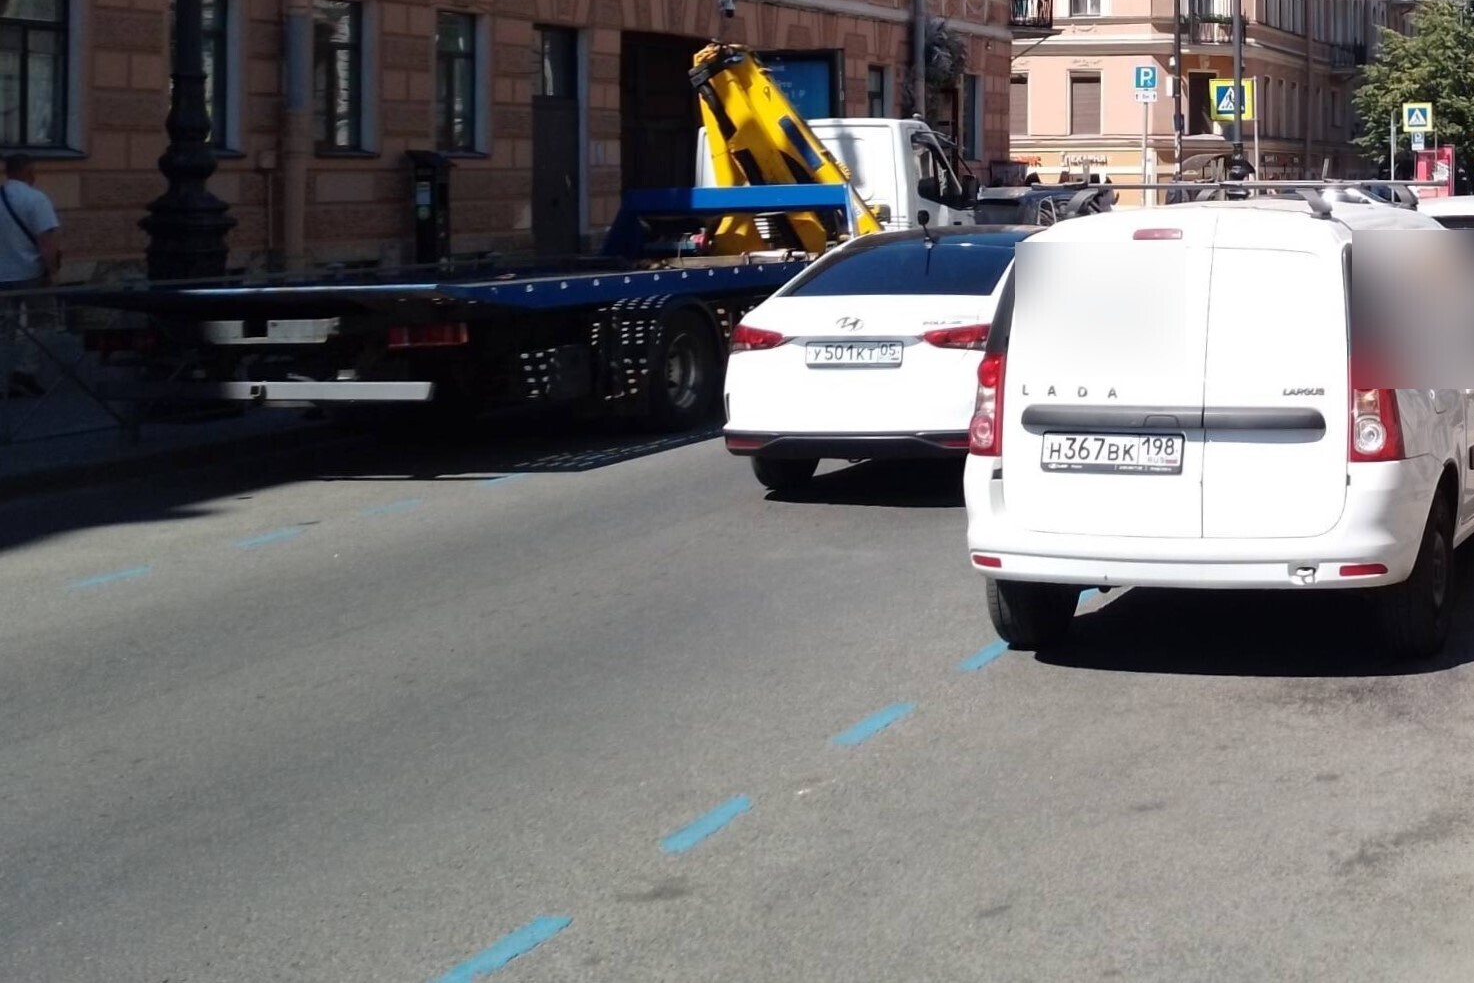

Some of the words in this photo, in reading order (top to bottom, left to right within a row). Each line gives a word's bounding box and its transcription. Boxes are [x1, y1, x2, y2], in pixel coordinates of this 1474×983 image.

[1140, 67, 1154, 87] P
[880, 343, 897, 357] 05
[1021, 384, 1118, 399] LADA
[1049, 436, 1135, 462] Н367ВК
[1142, 436, 1175, 456] 198
